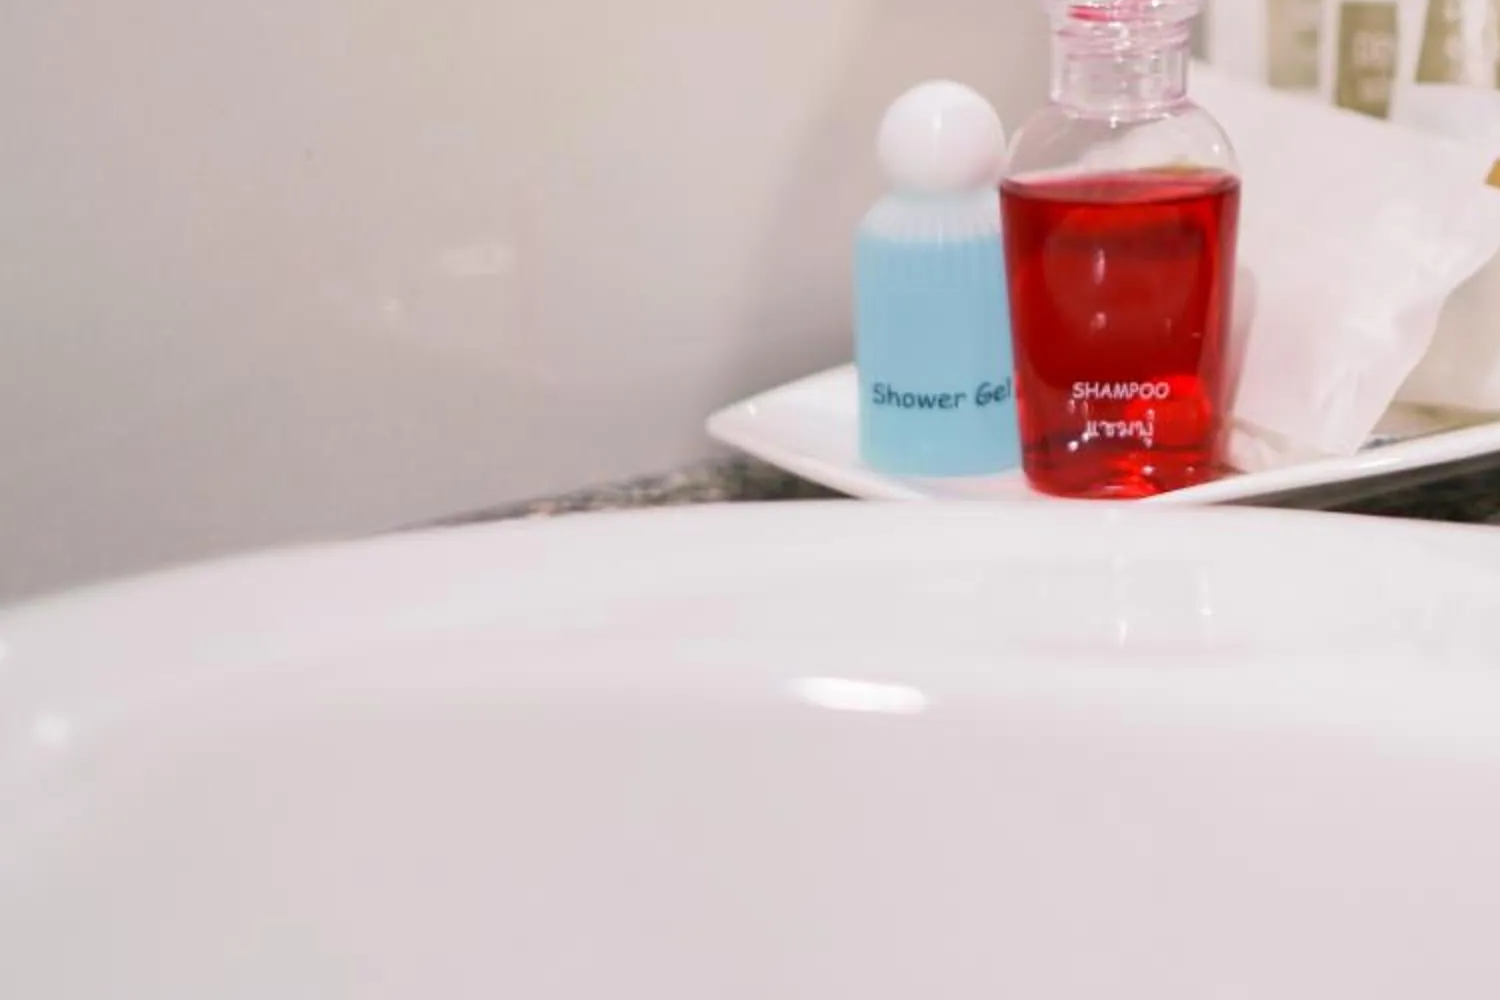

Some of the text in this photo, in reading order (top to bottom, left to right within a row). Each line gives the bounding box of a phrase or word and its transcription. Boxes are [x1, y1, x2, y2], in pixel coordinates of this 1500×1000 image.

[871, 375, 1013, 409] Shower Gel
[1071, 380, 1171, 401] SHAMPOO
